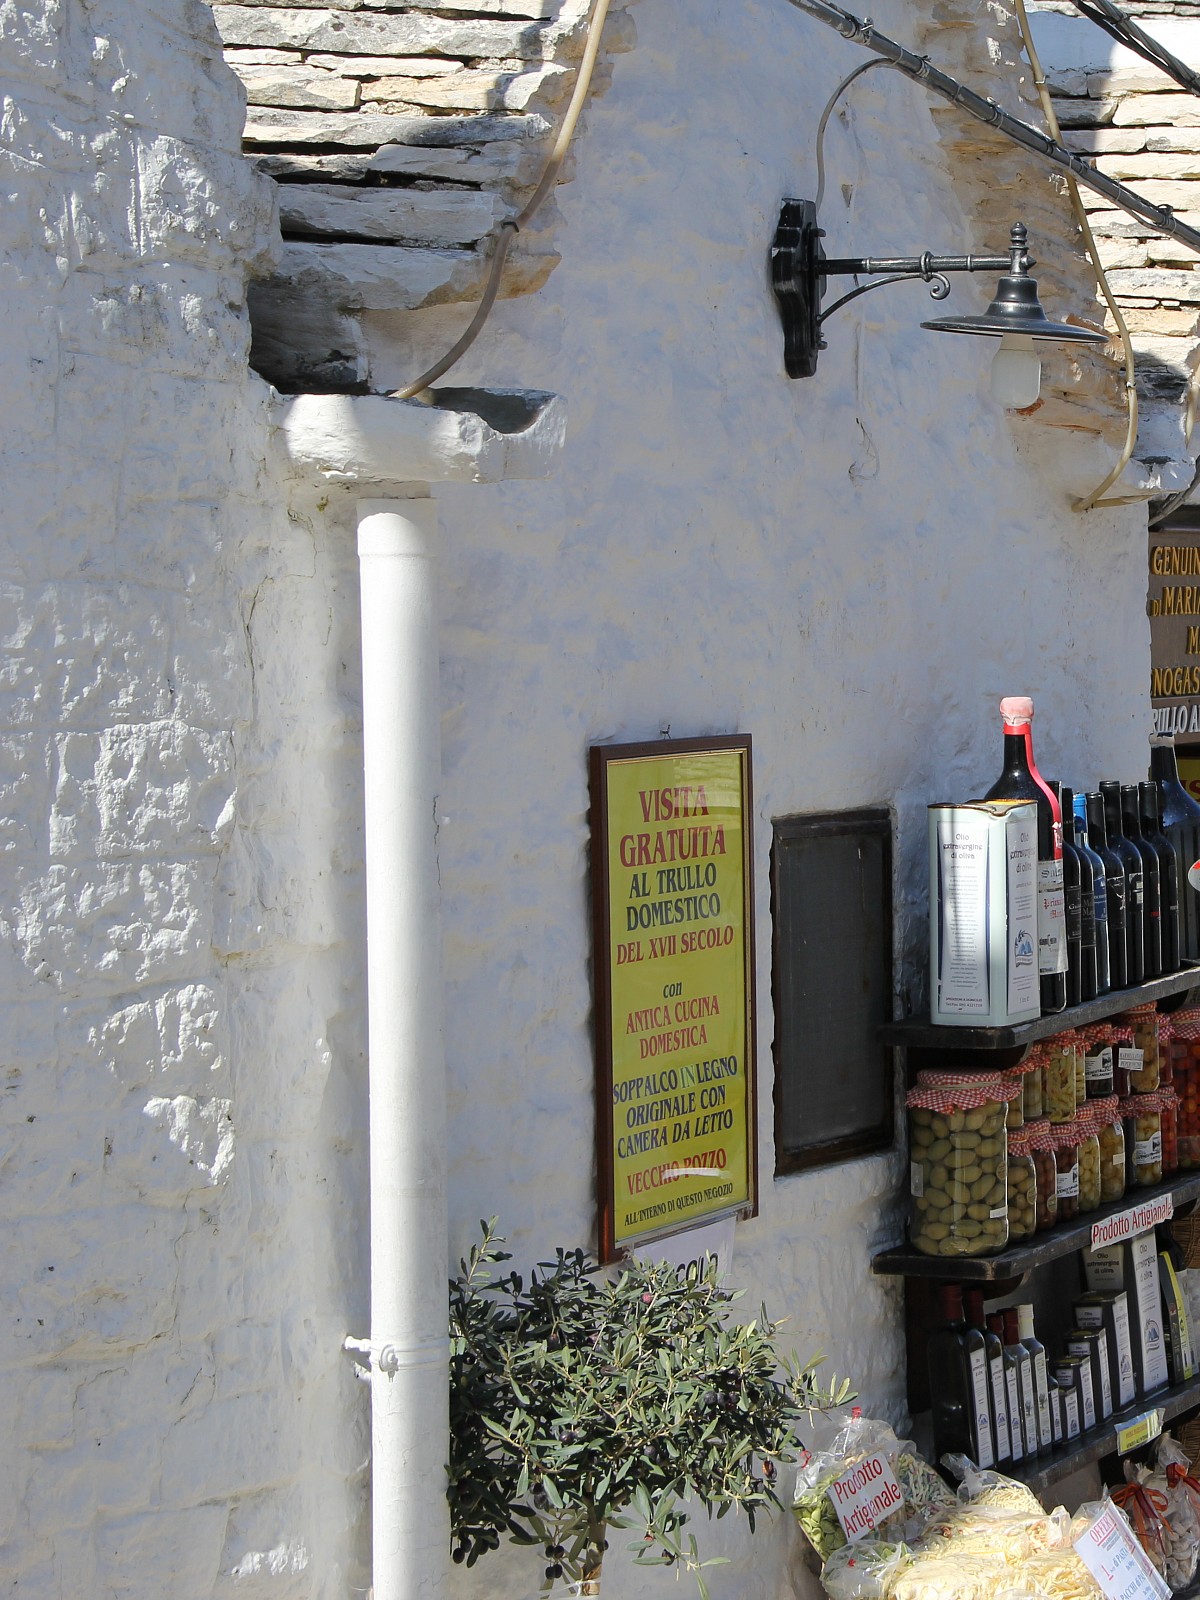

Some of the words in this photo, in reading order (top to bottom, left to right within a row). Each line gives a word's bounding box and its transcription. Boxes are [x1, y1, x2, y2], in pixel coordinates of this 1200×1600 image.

[1152, 705, 1187, 734] RULLO
[639, 785, 710, 823] VISITA
[619, 824, 726, 868] GRATUITA
[956, 833, 969, 841] Olio
[629, 872, 650, 899] AL
[656, 862, 717, 894] TRULLO
[626, 893, 721, 931] DOMESTICO
[616, 941, 644, 965] DEL
[648, 934, 677, 960] XVII
[681, 925, 734, 951] SECOLO
[663, 981, 683, 999] con
[626, 1004, 671, 1034] ANTICA
[674, 995, 720, 1022] CUCINA
[640, 1024, 707, 1060] DOMESTICA
[613, 1069, 678, 1105] SOPPALCO
[680, 1063, 696, 1090] IN
[697, 1055, 738, 1083] LEGNO
[626, 1093, 696, 1129] ORIGINALE
[700, 1084, 726, 1111] CON
[617, 1126, 668, 1159] CAMERA
[672, 1120, 690, 1144] DA
[694, 1108, 733, 1138] LETTO
[627, 1161, 680, 1196] VECCHIO
[683, 1148, 727, 1179] POZZO
[624, 1202, 667, 1226] ALL'INTERNO
[667, 1198, 676, 1212] DI
[676, 1190, 703, 1211] QUESTO
[703, 1182, 733, 1202] NEGOZIO
[1092, 1217, 1130, 1245] Prodotto
[1132, 1197, 1172, 1230] Artigianale
[833, 1459, 883, 1504] Prodotto
[843, 1481, 901, 1538] Artigianale
